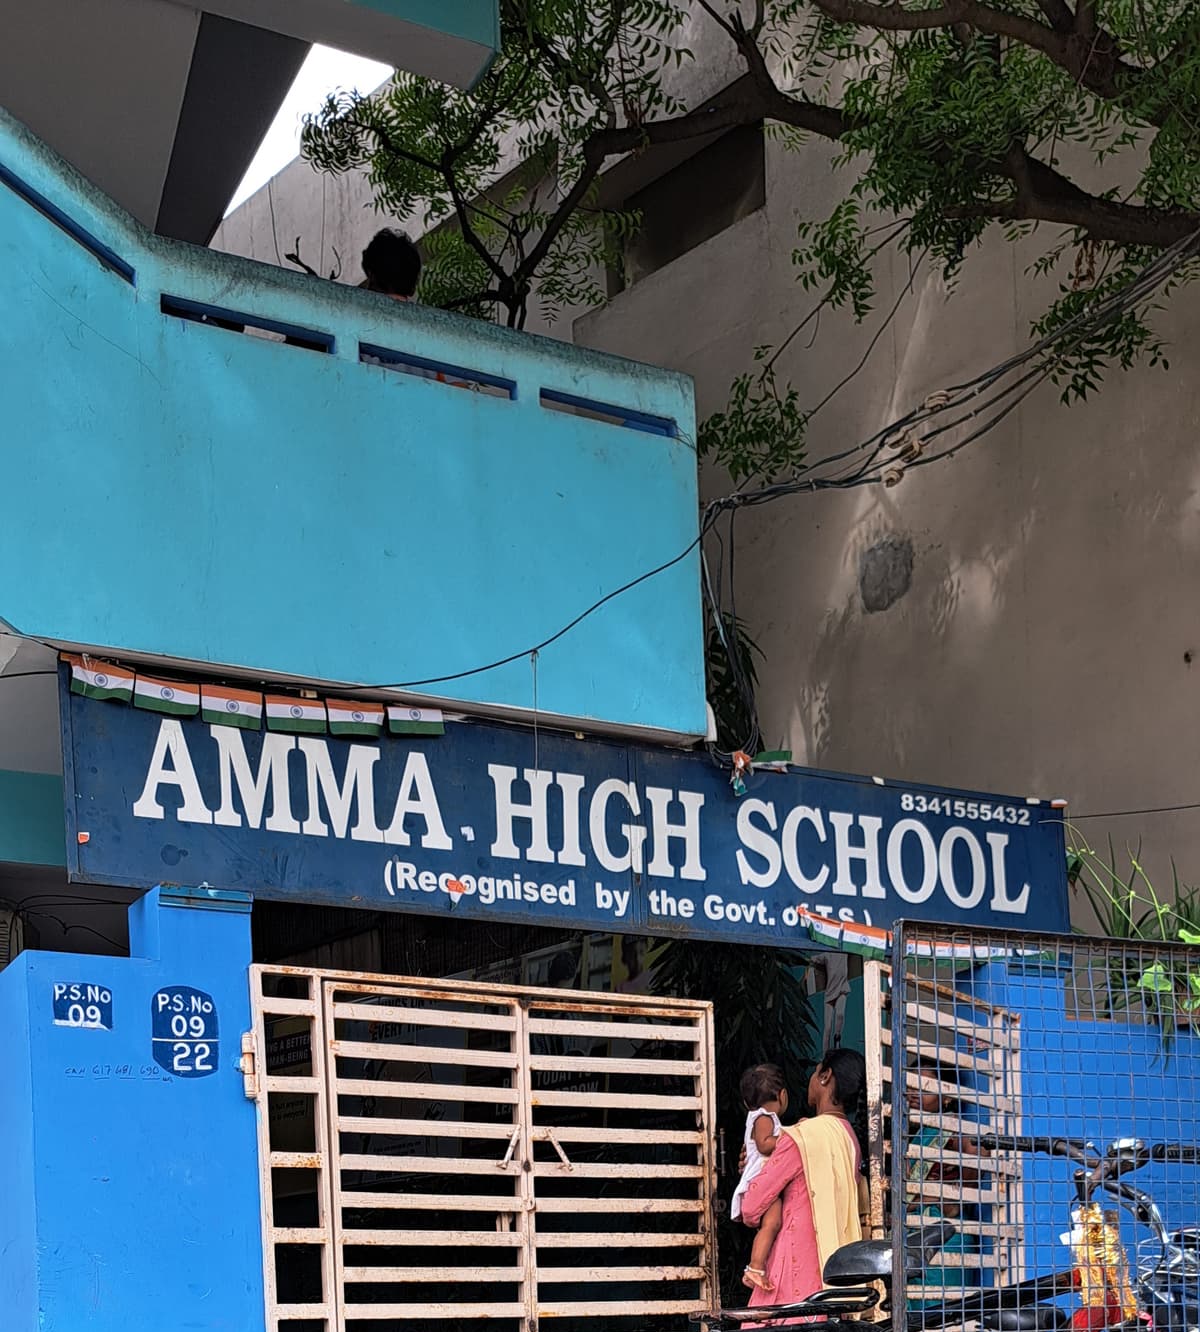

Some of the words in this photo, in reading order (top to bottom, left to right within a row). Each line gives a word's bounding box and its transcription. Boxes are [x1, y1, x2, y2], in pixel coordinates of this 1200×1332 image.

[133, 719, 453, 851] AMMA
[488, 763, 706, 881] HIGH
[736, 798, 1030, 914] SCHOOL
[900, 794, 1031, 826] 8341555432
[384, 860, 576, 907] (Recognised
[595, 882, 630, 917] by
[649, 889, 694, 919] the
[704, 895, 775, 926] Govt.
[68, 1003, 101, 1025] 09
[171, 1015, 205, 1038] 09
[173, 1043, 213, 1071] 22
